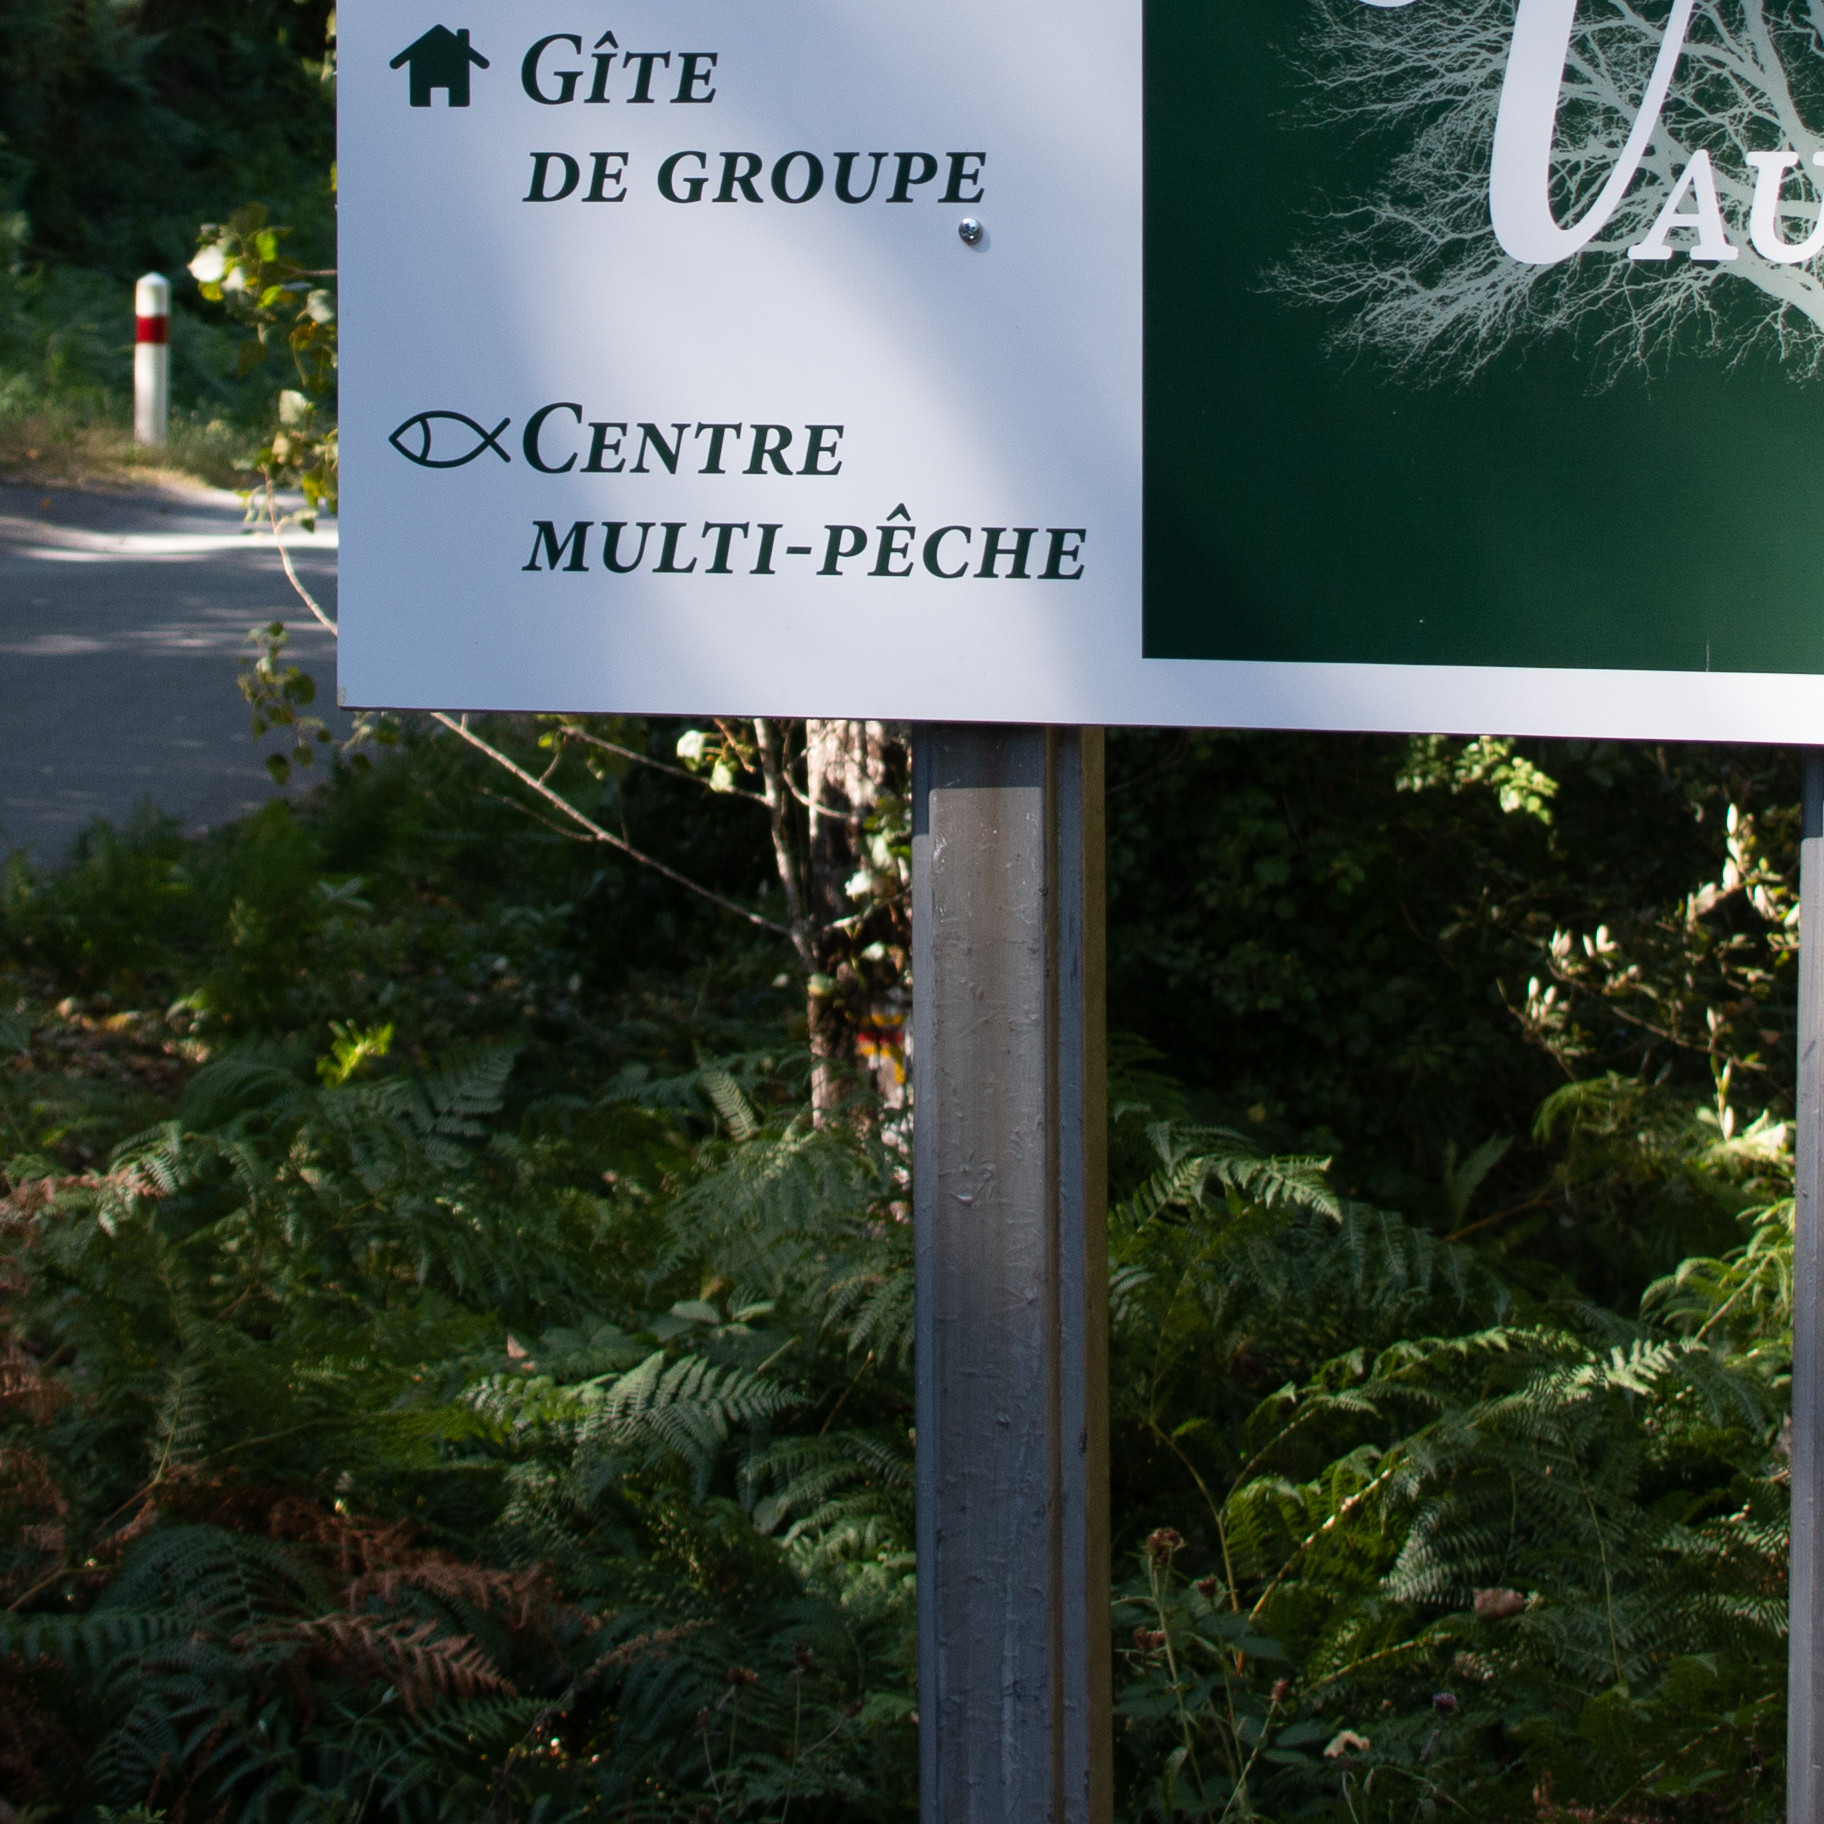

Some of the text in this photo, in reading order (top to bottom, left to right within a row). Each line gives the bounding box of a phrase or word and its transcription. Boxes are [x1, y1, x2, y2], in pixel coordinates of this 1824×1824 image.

[521, 30, 719, 106] GÎTE
[522, 150, 987, 205] DE GROUPE
[522, 402, 845, 476] CENTRE
[521, 503, 1087, 581] MULTI-PÊCHE
